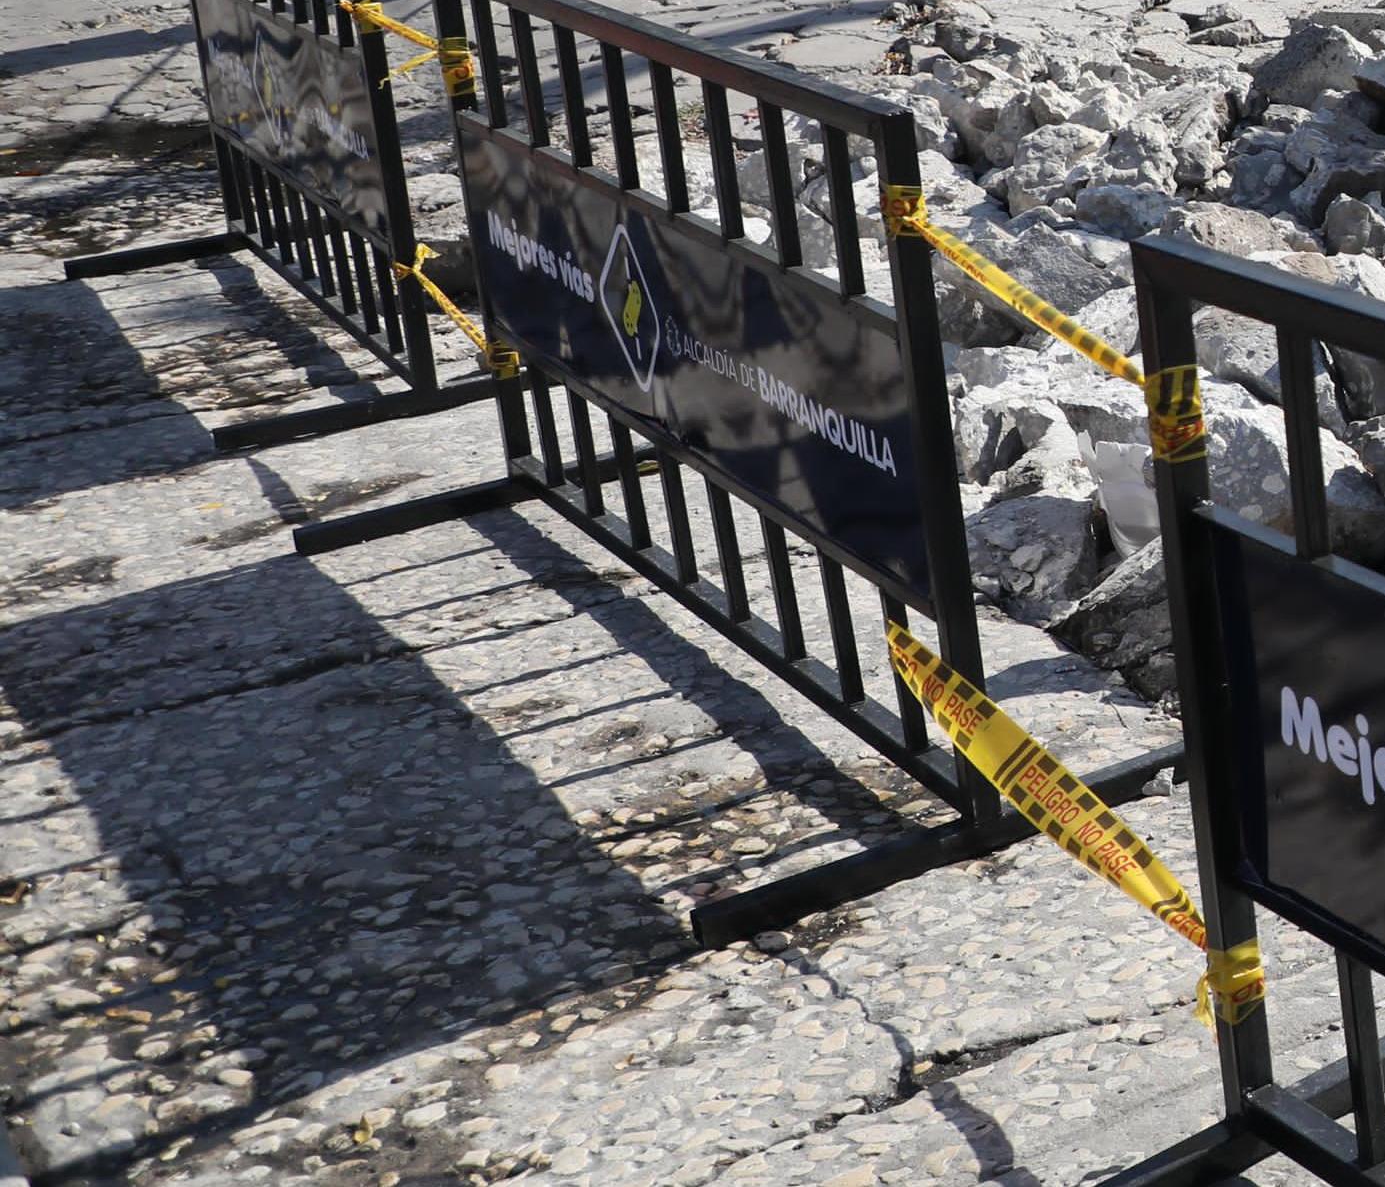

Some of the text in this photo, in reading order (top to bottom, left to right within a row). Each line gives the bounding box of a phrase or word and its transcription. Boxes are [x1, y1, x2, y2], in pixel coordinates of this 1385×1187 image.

[487, 210, 557, 279] Mejores
[683, 334, 897, 477] ALCALDÍA DE BARRANQUILLA
[922, 676, 945, 703] NO
[943, 695, 984, 736] PASE
[1018, 763, 1137, 880] PELIGRO NO PASE
